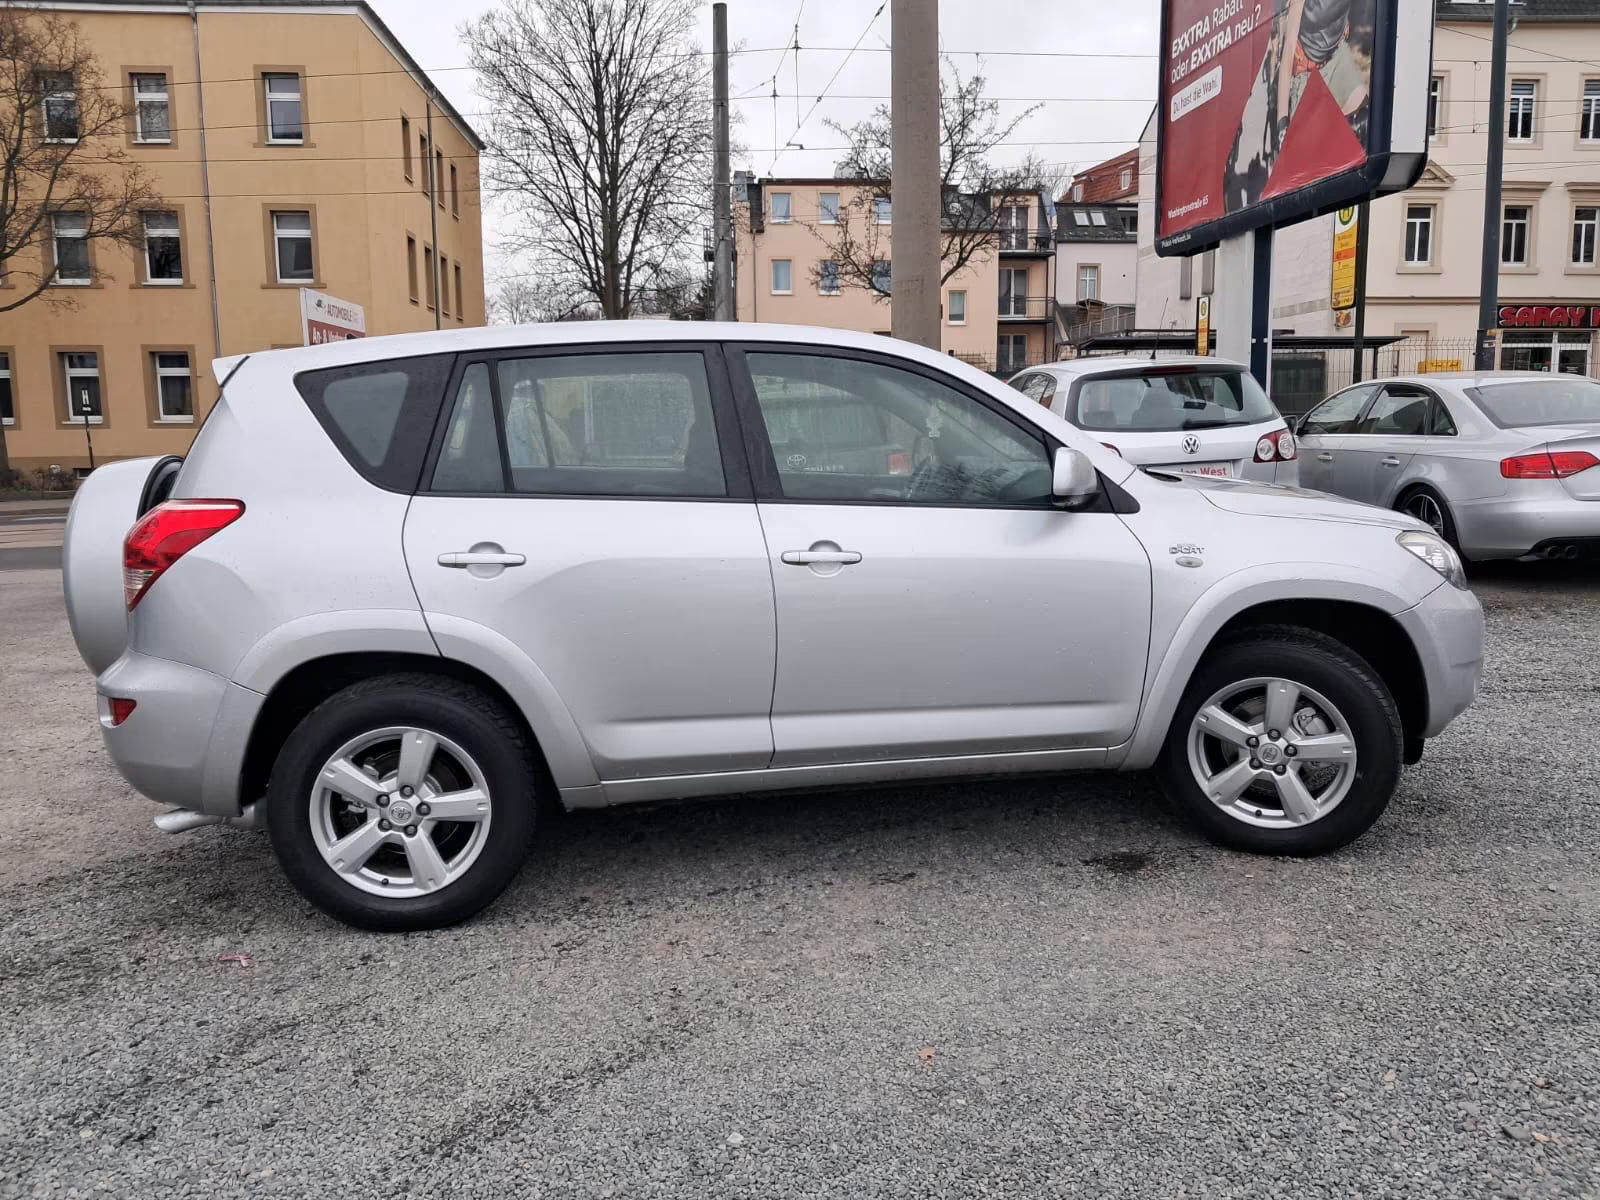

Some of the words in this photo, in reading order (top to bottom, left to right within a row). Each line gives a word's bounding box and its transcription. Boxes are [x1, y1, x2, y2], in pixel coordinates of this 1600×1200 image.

[1172, 16, 1210, 59] EXXTRA
[1171, 58, 1189, 84] oder
[1190, 25, 1232, 70] EXXTRA
[1173, 101, 1180, 114] Du
[1180, 93, 1192, 110] hast
[1193, 87, 1202, 101] die
[1499, 306, 1586, 327] SARAY
[1200, 467, 1227, 477] West
